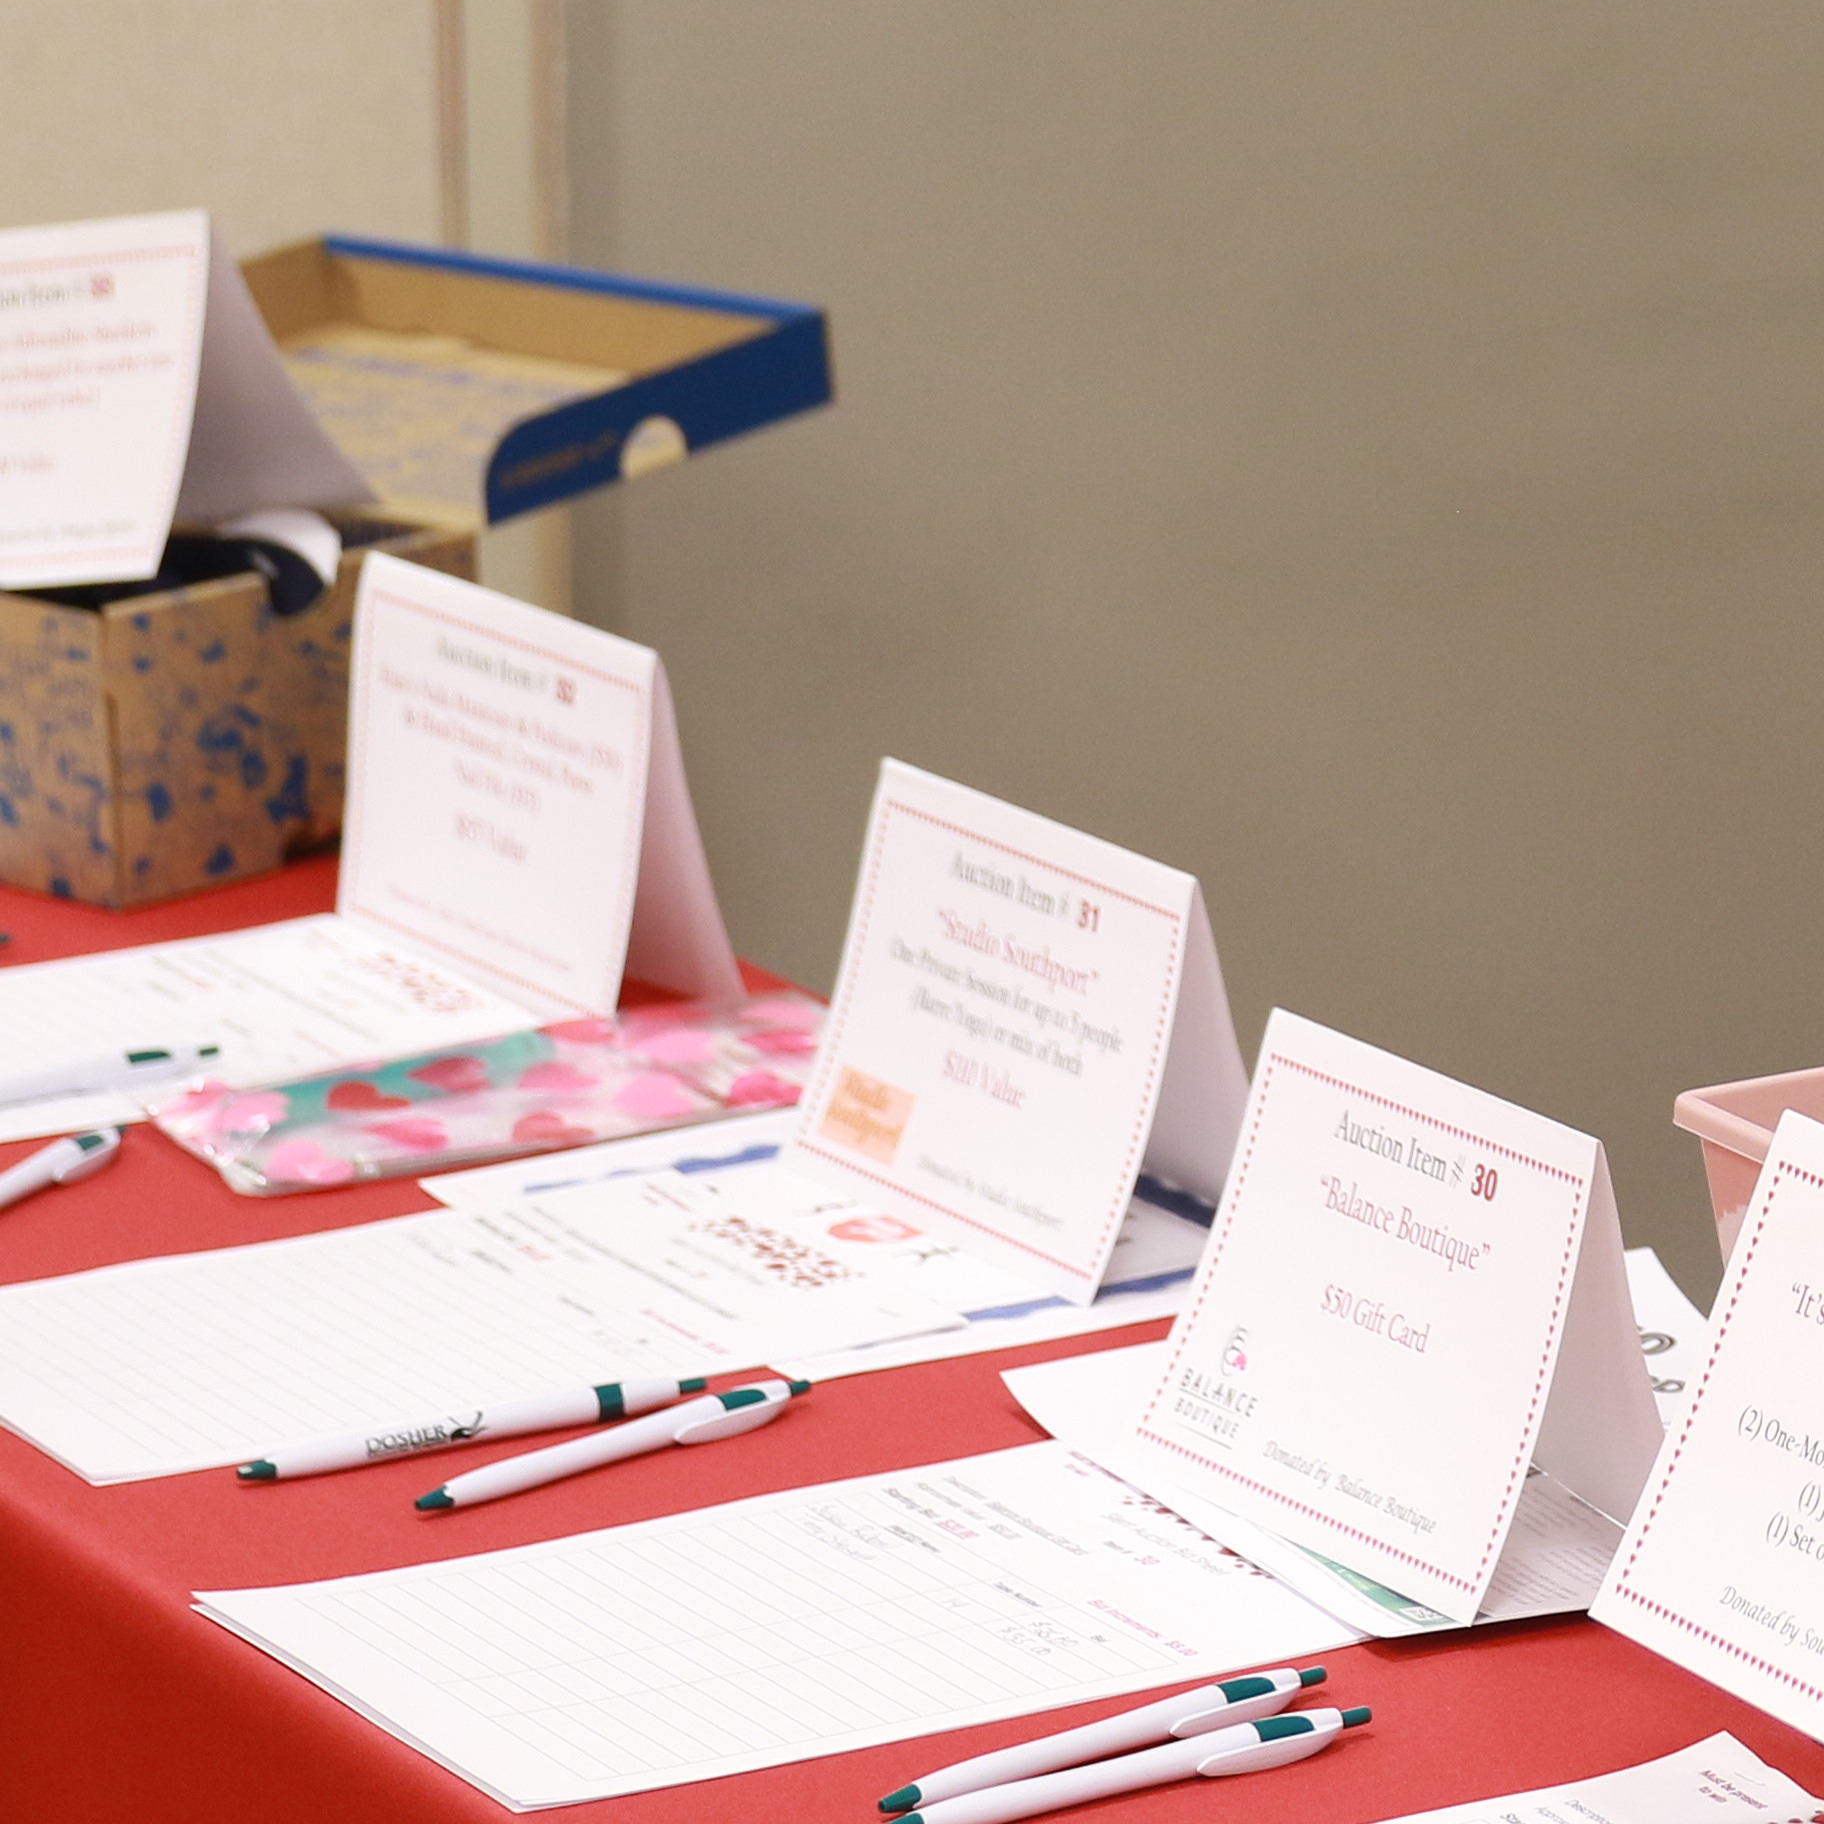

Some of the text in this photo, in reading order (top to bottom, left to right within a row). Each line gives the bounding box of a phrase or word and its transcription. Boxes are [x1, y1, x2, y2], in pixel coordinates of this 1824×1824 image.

[949, 851, 1014, 899] Auction
[1016, 876, 1055, 916] Item
[1076, 898, 1101, 933] 31
[1334, 1109, 1498, 1202] Auction Item # 30
[1320, 1174, 1491, 1272] “Balance Boutique”
[1320, 1282, 1431, 1353] $50 Gift Card
[1173, 1397, 1241, 1439] BOUTIQUE
[1180, 1367, 1259, 1418] BALANCE
[365, 1424, 449, 1454] DOSHER
[1738, 1404, 1763, 1441] (2)
[1262, 1440, 1438, 1535] Donated by Balance Boutique
[1798, 1479, 1822, 1517] (1)
[1765, 1511, 1790, 1548] (1)
[1788, 1524, 1815, 1555] Set
[1719, 1585, 1788, 1631] Donated
[1780, 1614, 1800, 1647] by
